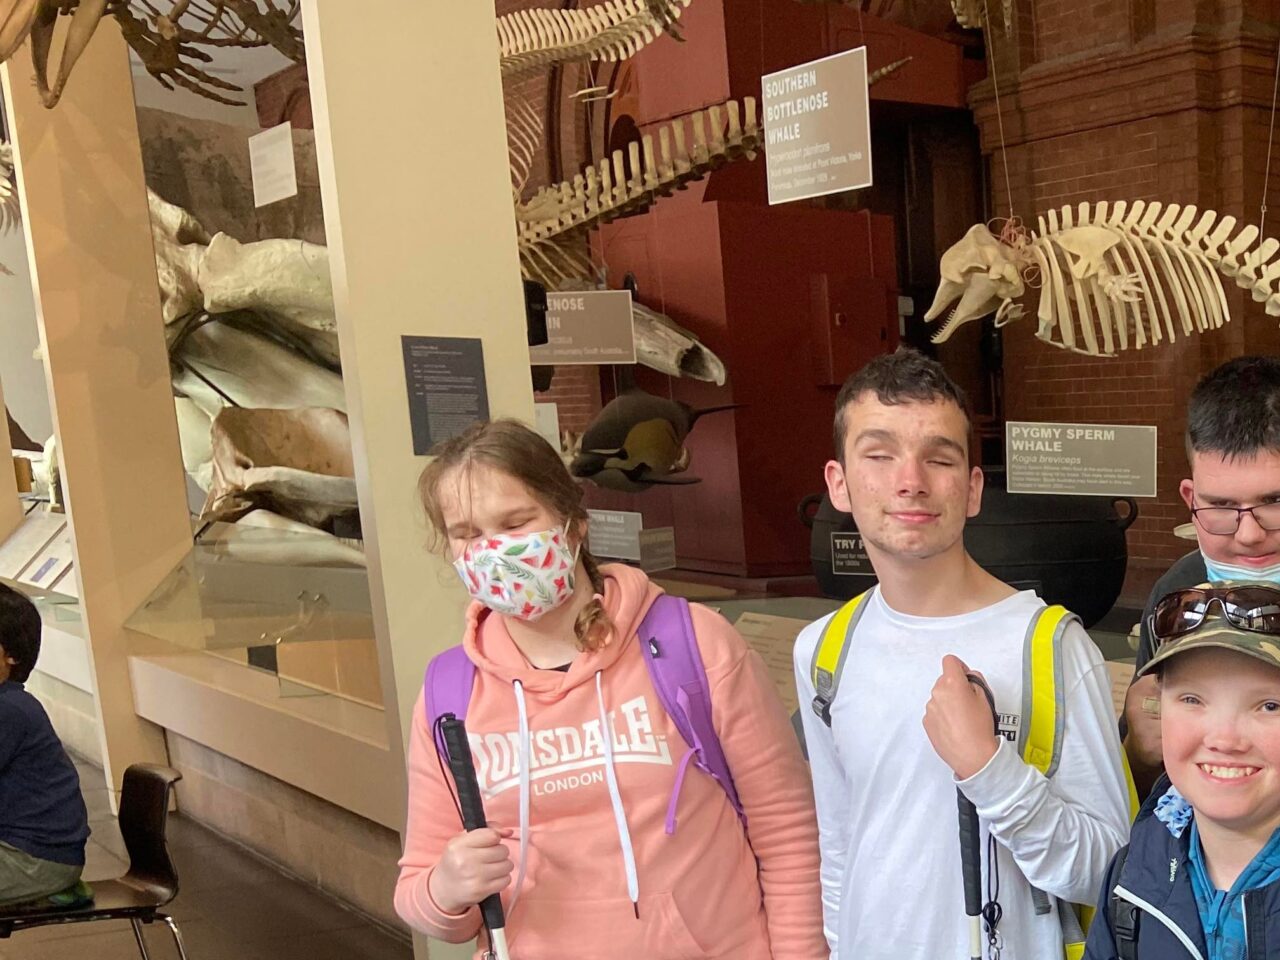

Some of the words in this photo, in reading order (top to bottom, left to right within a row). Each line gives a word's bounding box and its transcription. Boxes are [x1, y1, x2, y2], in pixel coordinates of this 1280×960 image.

[766, 70, 816, 98] SOUTHERN
[767, 92, 829, 121] BOTTLENOSE
[768, 123, 801, 145] WHALE
[547, 298, 585, 311] ENOSE
[1012, 427, 1062, 438] PYGMY
[1066, 428, 1115, 440] SPERM
[1012, 440, 1062, 452] WHALE
[1012, 454, 1037, 464] Kogia
[1039, 455, 1081, 465] breviceps
[834, 539, 856, 549] TRY
[533, 770, 604, 797] LONDON
